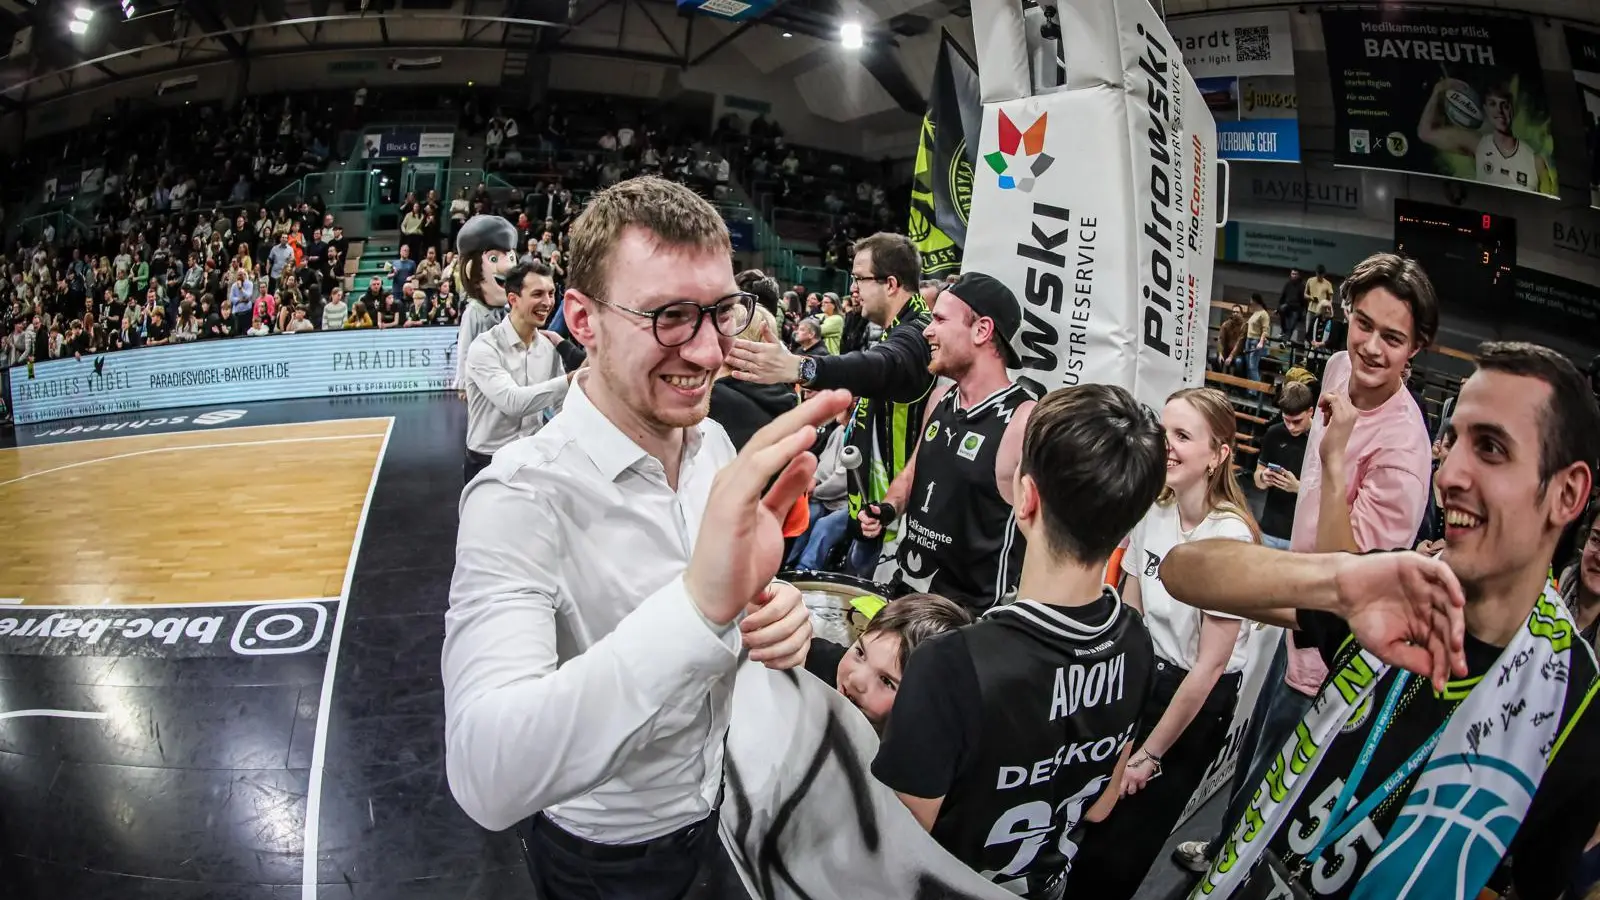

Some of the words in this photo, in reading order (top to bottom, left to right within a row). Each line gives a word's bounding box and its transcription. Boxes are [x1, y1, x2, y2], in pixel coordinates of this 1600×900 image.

[1360, 21, 1437, 36] Medikamente
[1440, 26, 1460, 38] per
[1461, 26, 1491, 39] Klick
[1208, 54, 1231, 66] light
[1363, 37, 1496, 66] BAYREUTH
[386, 142, 407, 152] Block
[409, 142, 417, 151] G
[1171, 58, 1184, 214] INDUSTRIESERVICE
[1217, 130, 1255, 152] WERBUNG
[1257, 131, 1278, 153] GEHT
[1136, 22, 1172, 358] Piotrowski
[1188, 133, 1202, 252] PioConsult
[1251, 178, 1359, 204] BAYREUTH
[1176, 221, 1186, 260] UND
[1062, 216, 1097, 386] USTRIESERVICE
[1174, 268, 1186, 361] GEBÄUDE-
[333, 347, 431, 371] PARADIES
[19, 378, 80, 401] PARADIES
[87, 370, 133, 394] VOGEL
[150, 361, 290, 389] PARADIESVOGEL-BAYREUTH.DE
[328, 383, 352, 393] WEINE
[365, 380, 419, 391] SPIRITUOSEN
[34, 415, 189, 438] schlaeger
[920, 480, 937, 514] 1
[916, 534, 937, 552] Klick
[1050, 652, 1125, 721] ADOYI
[1360, 742, 1376, 766] Klick
[1383, 769, 1406, 793] Klick
